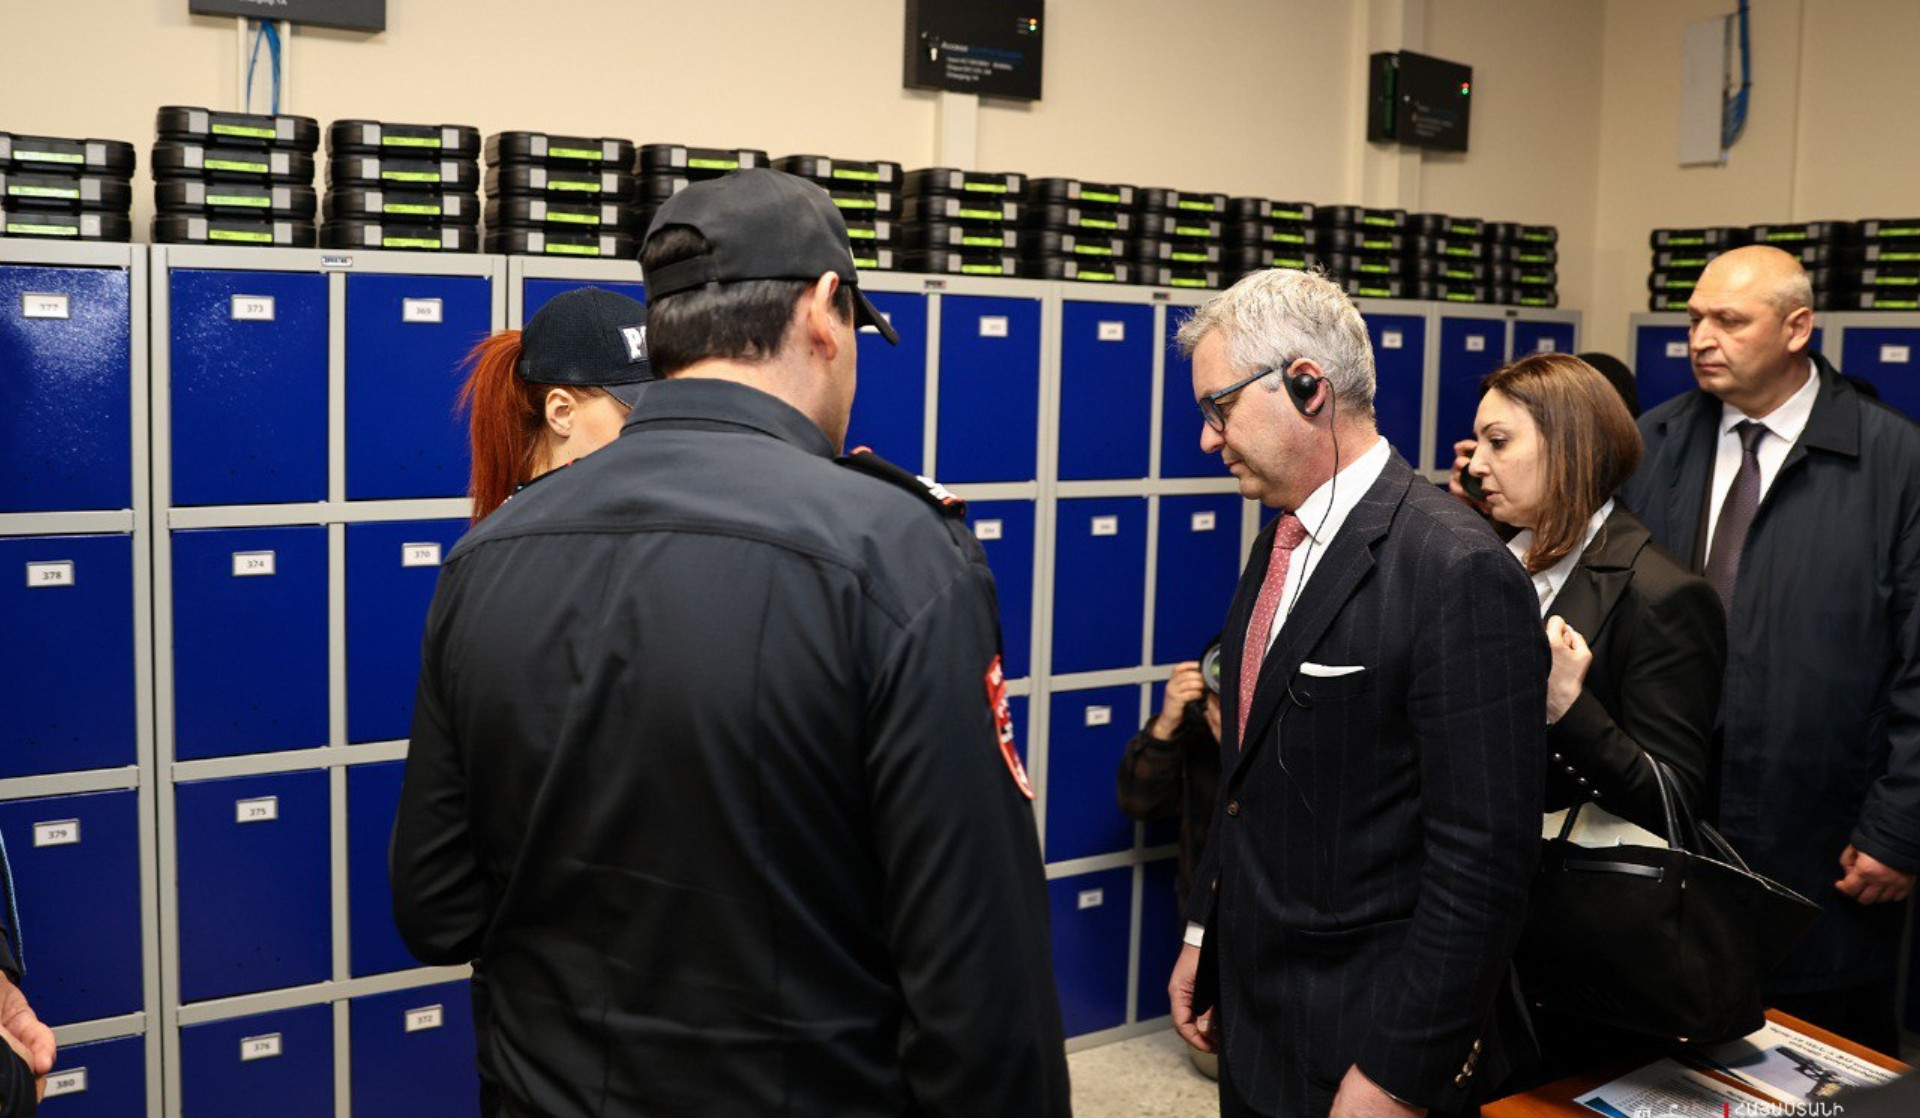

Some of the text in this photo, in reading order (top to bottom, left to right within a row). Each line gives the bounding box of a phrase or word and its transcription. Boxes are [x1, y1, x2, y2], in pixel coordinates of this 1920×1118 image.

[247, 304, 264, 313] 373
[415, 548, 431, 558] 370
[247, 560, 265, 569] 374
[43, 571, 62, 581] 378
[249, 808, 266, 818] 375
[48, 829, 67, 840] 379
[417, 1015, 433, 1025] 372
[254, 1042, 271, 1052] 376
[57, 1078, 75, 1090] 380
